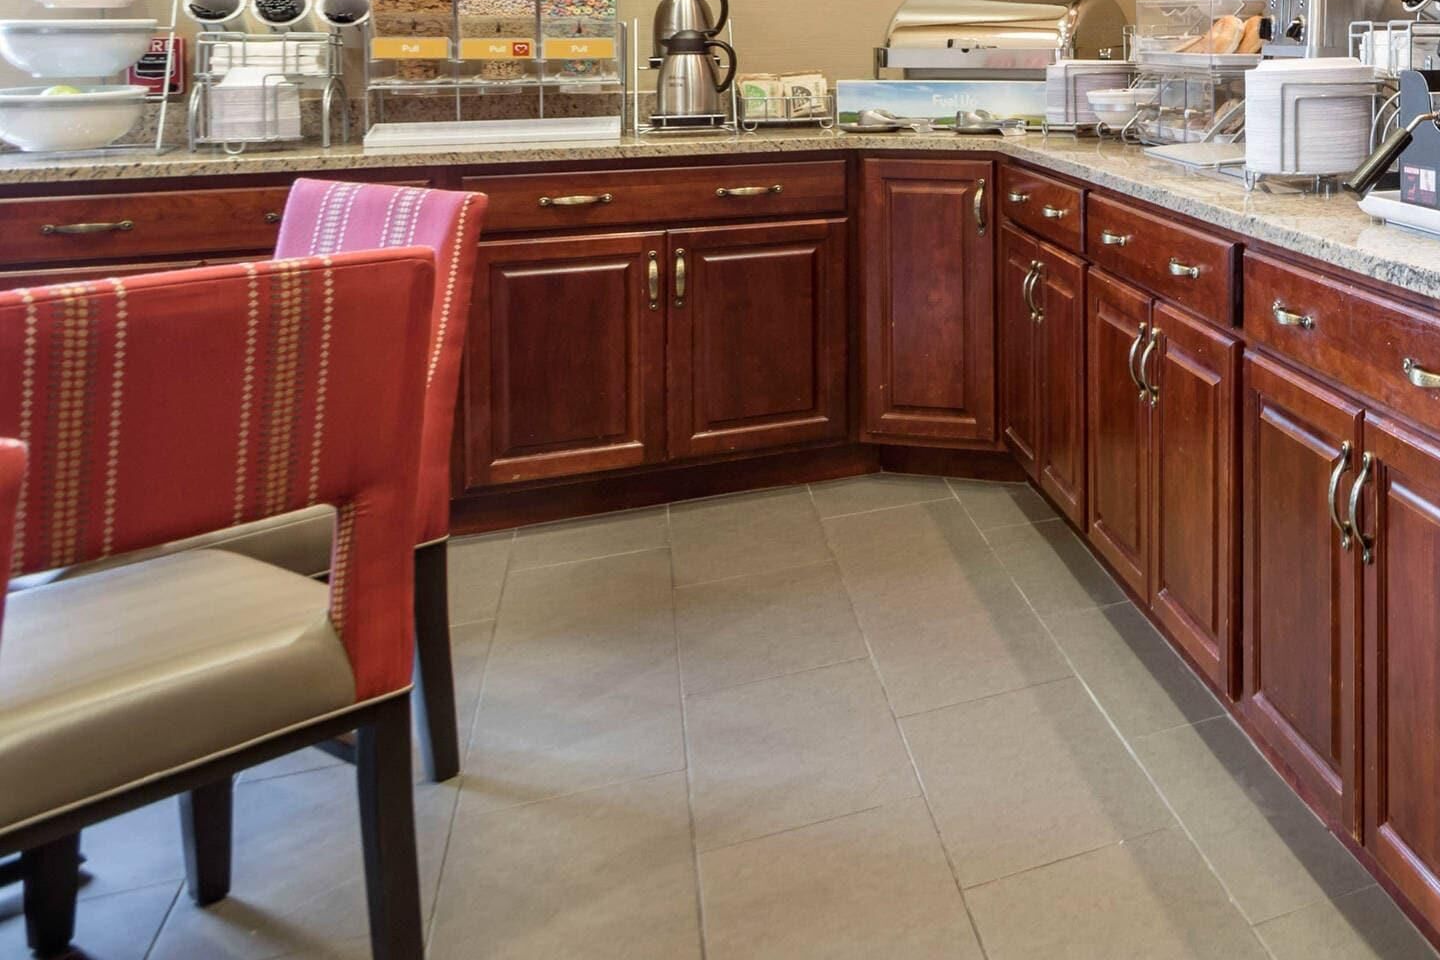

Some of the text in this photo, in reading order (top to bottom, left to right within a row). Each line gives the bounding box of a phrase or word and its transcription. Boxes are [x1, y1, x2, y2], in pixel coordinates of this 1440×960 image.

[401, 44, 421, 54] Pull
[488, 44, 507, 54] Pull
[571, 44, 588, 54] Pull
